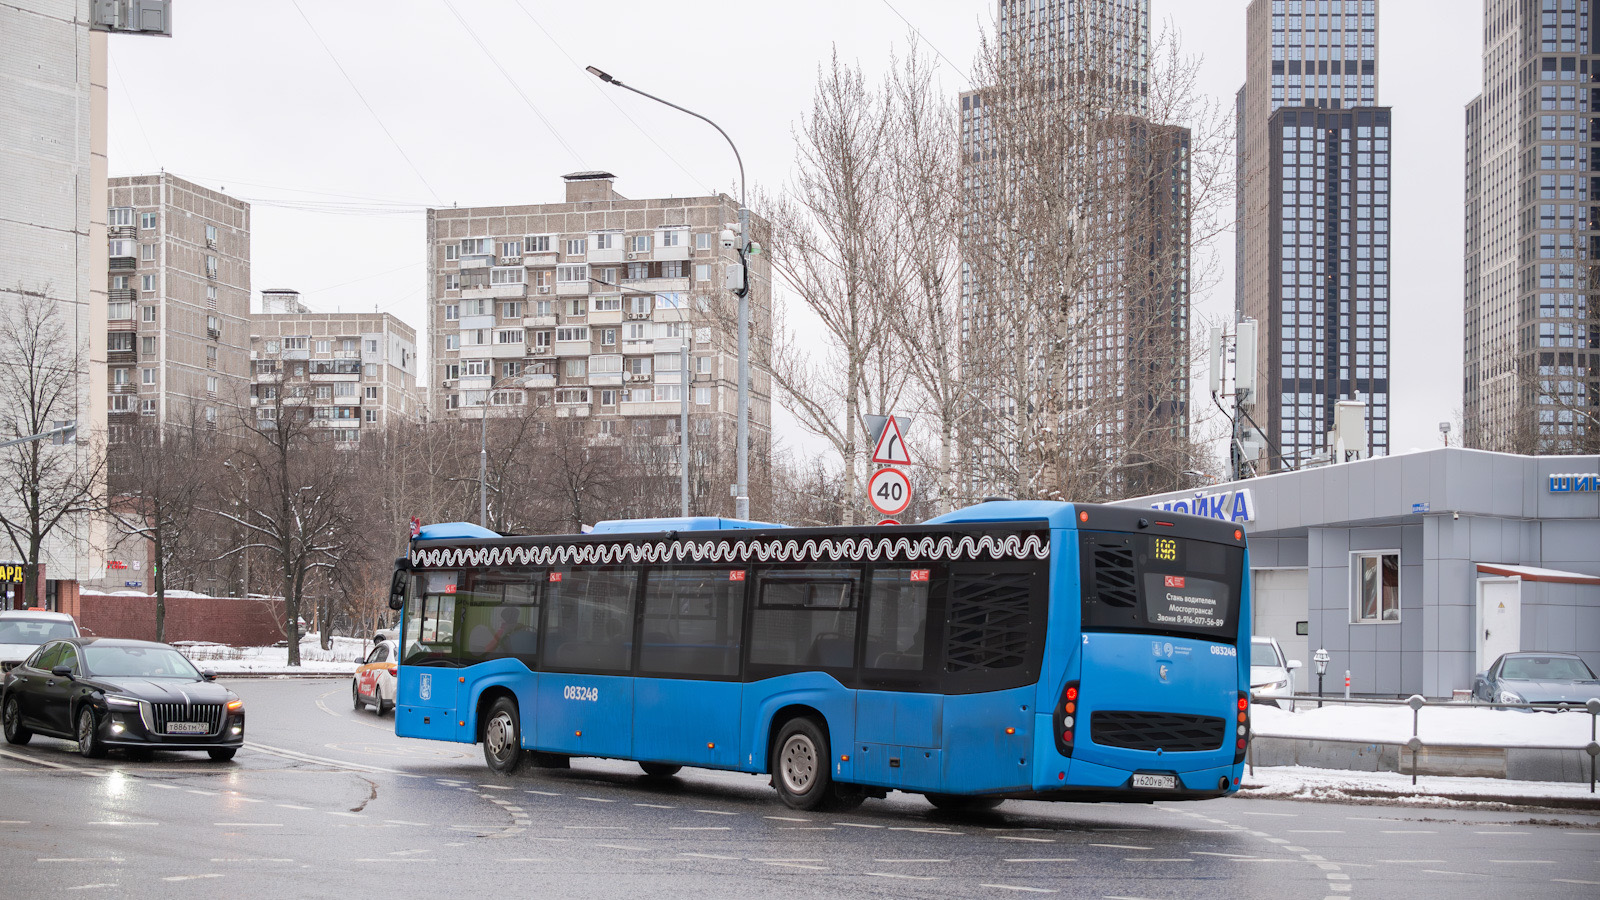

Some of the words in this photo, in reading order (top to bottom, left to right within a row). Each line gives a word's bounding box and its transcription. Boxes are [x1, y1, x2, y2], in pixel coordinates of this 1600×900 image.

[877, 482, 902, 500] 40
[1155, 538, 1176, 561] 198
[1166, 592, 1183, 601] Стань
[1184, 597, 1216, 605] водителем
[1169, 604, 1213, 615] Мосгортранса!
[1157, 613, 1176, 623] Звони
[1177, 615, 1224, 626] 8-916-077-56-89
[1082, 634, 1089, 644] 2
[1210, 645, 1237, 657] 083248
[564, 685, 598, 701] 083248
